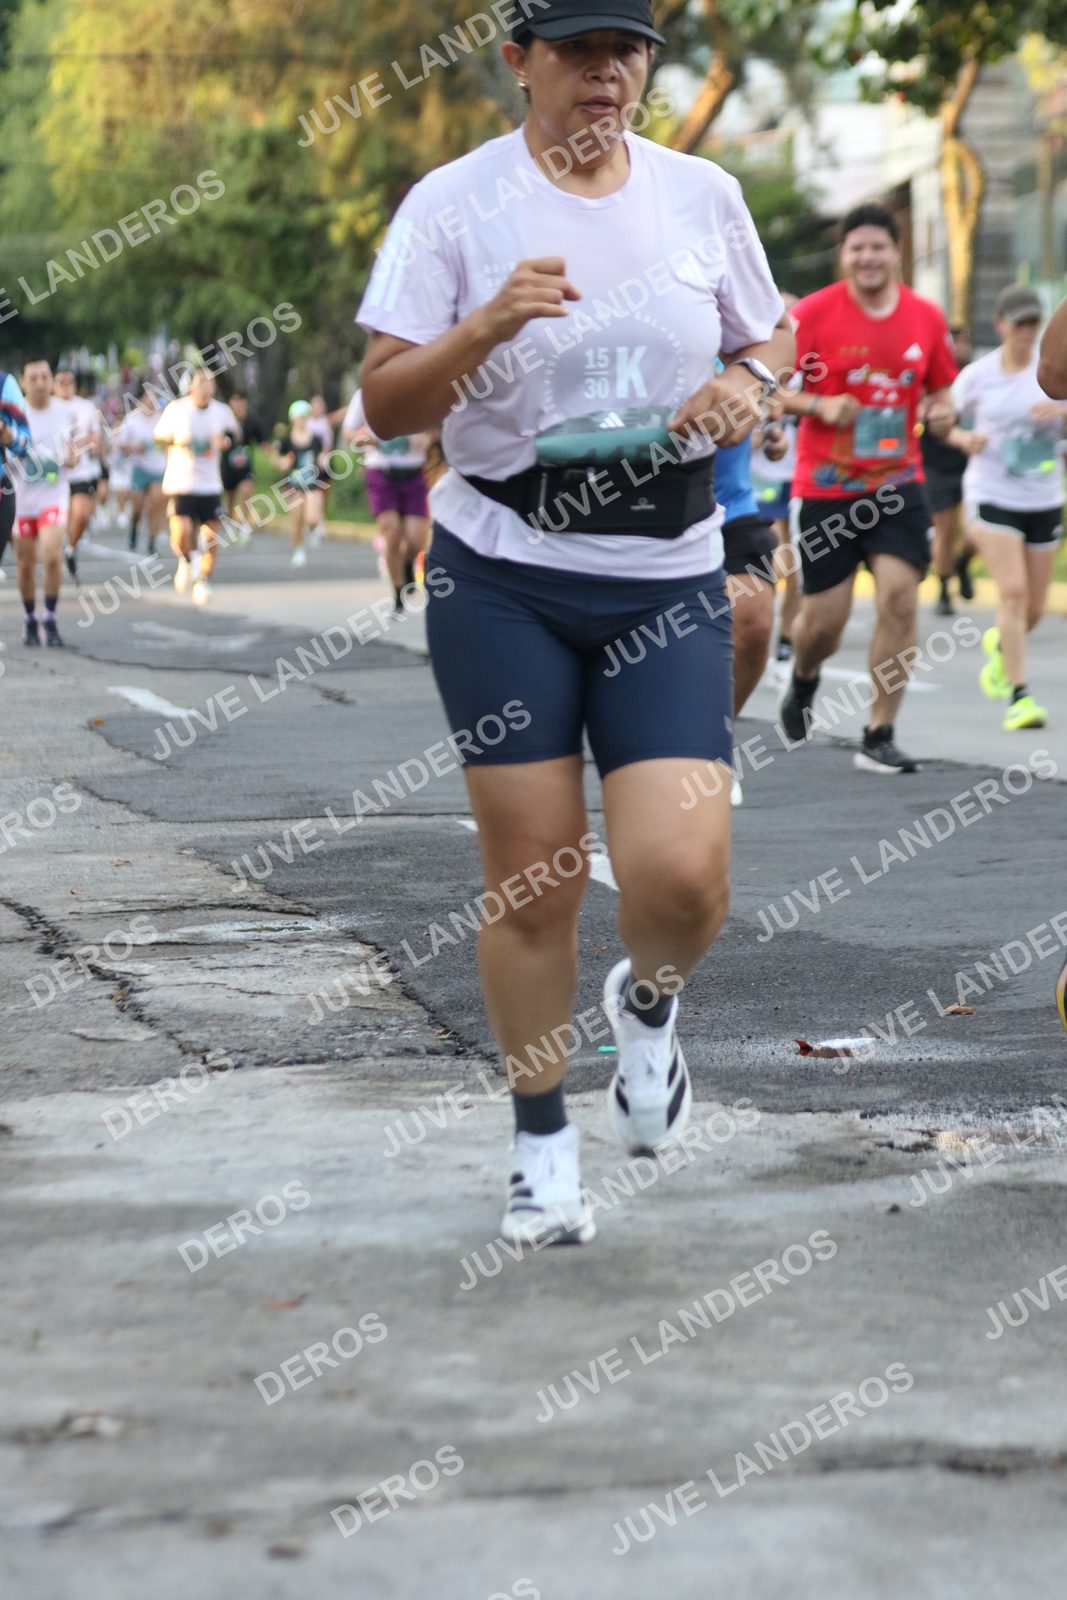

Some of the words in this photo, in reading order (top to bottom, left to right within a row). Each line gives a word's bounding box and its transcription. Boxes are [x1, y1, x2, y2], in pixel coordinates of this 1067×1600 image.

[584, 347, 610, 369] 15
[615, 345, 649, 399] K
[584, 377, 610, 400] 30
